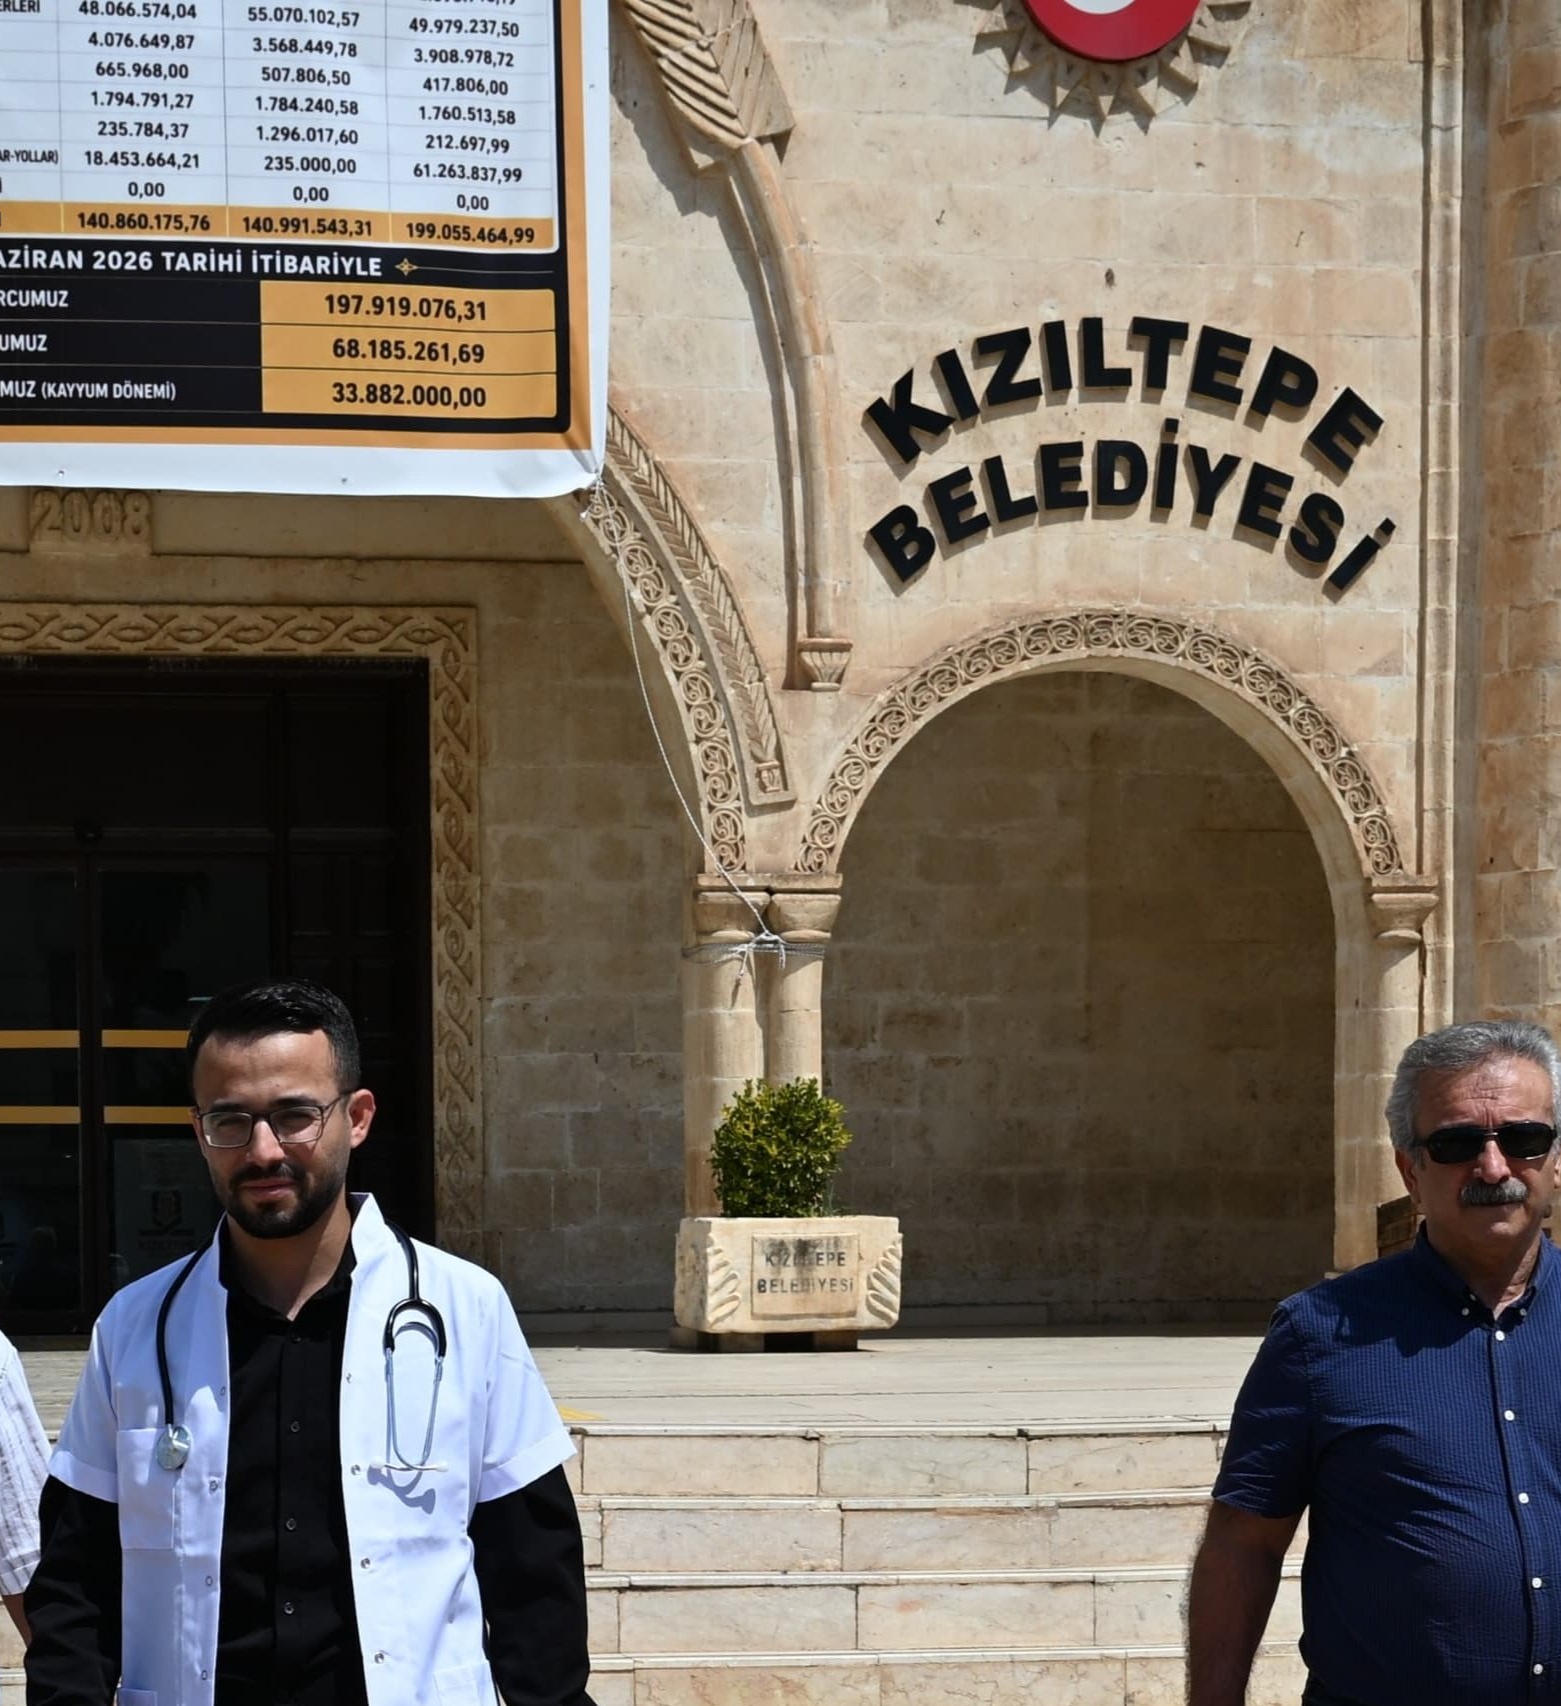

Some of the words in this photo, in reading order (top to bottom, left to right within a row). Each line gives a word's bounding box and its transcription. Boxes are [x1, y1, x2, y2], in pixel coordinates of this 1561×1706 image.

[79, 2, 197, 20] 48.066.574,04
[248, 7, 359, 28] 55.070.102,57
[409, 18, 519, 38] 49.979.237,50
[88, 32, 195, 50] 4.076.649,87
[253, 38, 357, 58] 3.568.449,78
[414, 48, 515, 68] 3.908.978,72
[95, 62, 189, 80] 665.968,00
[261, 66, 351, 86] 507.806,50
[423, 78, 509, 96] 417.806,00
[91, 91, 194, 110] 1.794.791,27
[255, 96, 359, 116] 1.784.240,58
[419, 106, 516, 125] 1.760.513,58
[97, 121, 189, 139] 235.784,37
[257, 126, 359, 145] 1.296.017,60
[425, 135, 509, 154] 212.697,99
[85, 150, 199, 170] 18.453.664,21
[264, 156, 357, 174] 235.000,00
[413, 163, 523, 183] 61.263.837,99
[128, 182, 165, 198] 0,00
[293, 186, 329, 202] 0,00
[457, 194, 489, 212] 0,00
[78, 212, 211, 232] 140.860.175,76
[243, 216, 372, 236] 140.991.543,31
[407, 222, 535, 245] 199.055.464,99
[92, 250, 153, 271] 2026
[162, 247, 242, 273] TARİHİ
[252, 249, 382, 276] İTİBARİYLE
[325, 294, 486, 322] 197.919.076,31
[332, 339, 485, 365] 68.185.261,69
[42, 382, 108, 399] (KAYYUM
[112, 381, 176, 401] DÖNEMİ)
[332, 383, 486, 409] 33.882.000,00
[865, 317, 1384, 473] KIZILTEPE
[30, 489, 152, 542] 2008
[869, 418, 1396, 591] BELEDİYESİ
